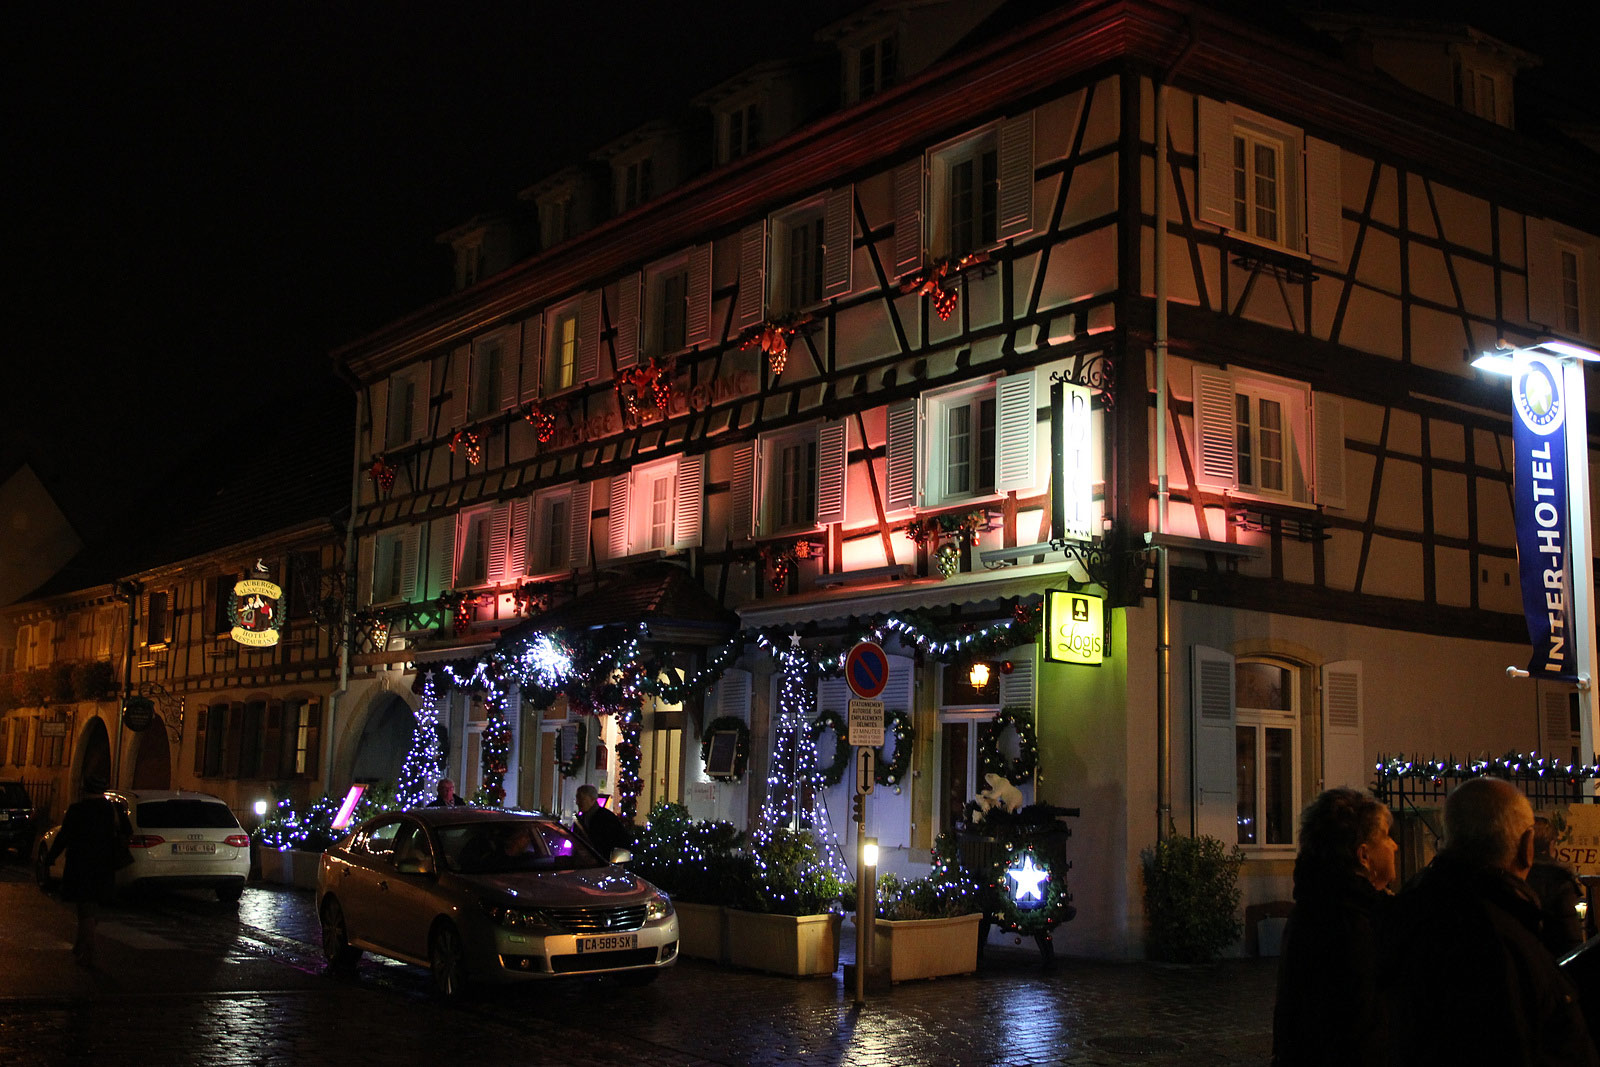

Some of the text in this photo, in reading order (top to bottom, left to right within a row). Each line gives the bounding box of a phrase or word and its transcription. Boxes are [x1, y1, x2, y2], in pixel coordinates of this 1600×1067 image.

[1530, 441, 1564, 673] INTER-HOTEL
[242, 581, 275, 591] AUBERGE
[234, 634, 275, 645] RESTAURANT
[242, 630, 268, 639] HOTEL
[1057, 622, 1101, 658] Logis
[585, 936, 631, 950] CA-589-SX
